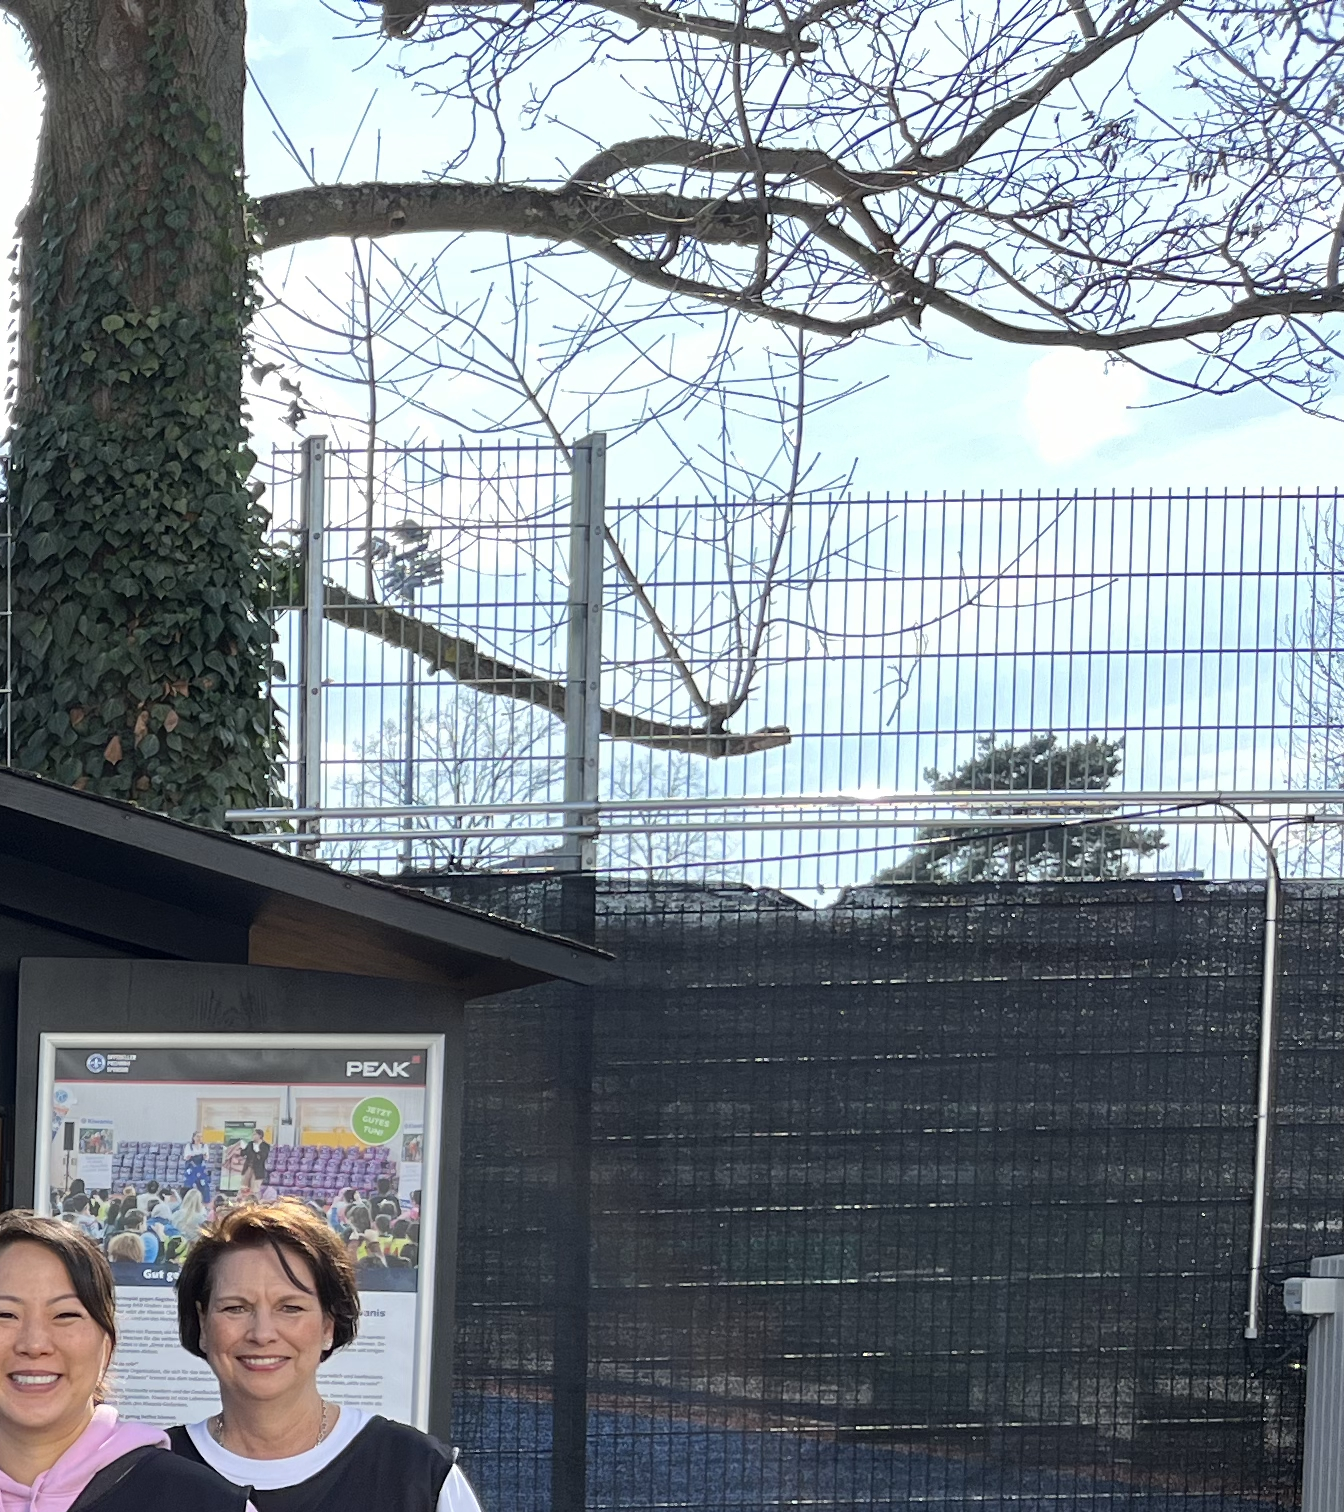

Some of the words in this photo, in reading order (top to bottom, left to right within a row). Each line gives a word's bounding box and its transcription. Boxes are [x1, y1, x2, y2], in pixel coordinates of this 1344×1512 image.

[346, 1061, 411, 1078] PEAK
[365, 1105, 393, 1118] JETZT
[362, 1115, 391, 1128] GUTES
[142, 1268, 165, 1280] Gut
